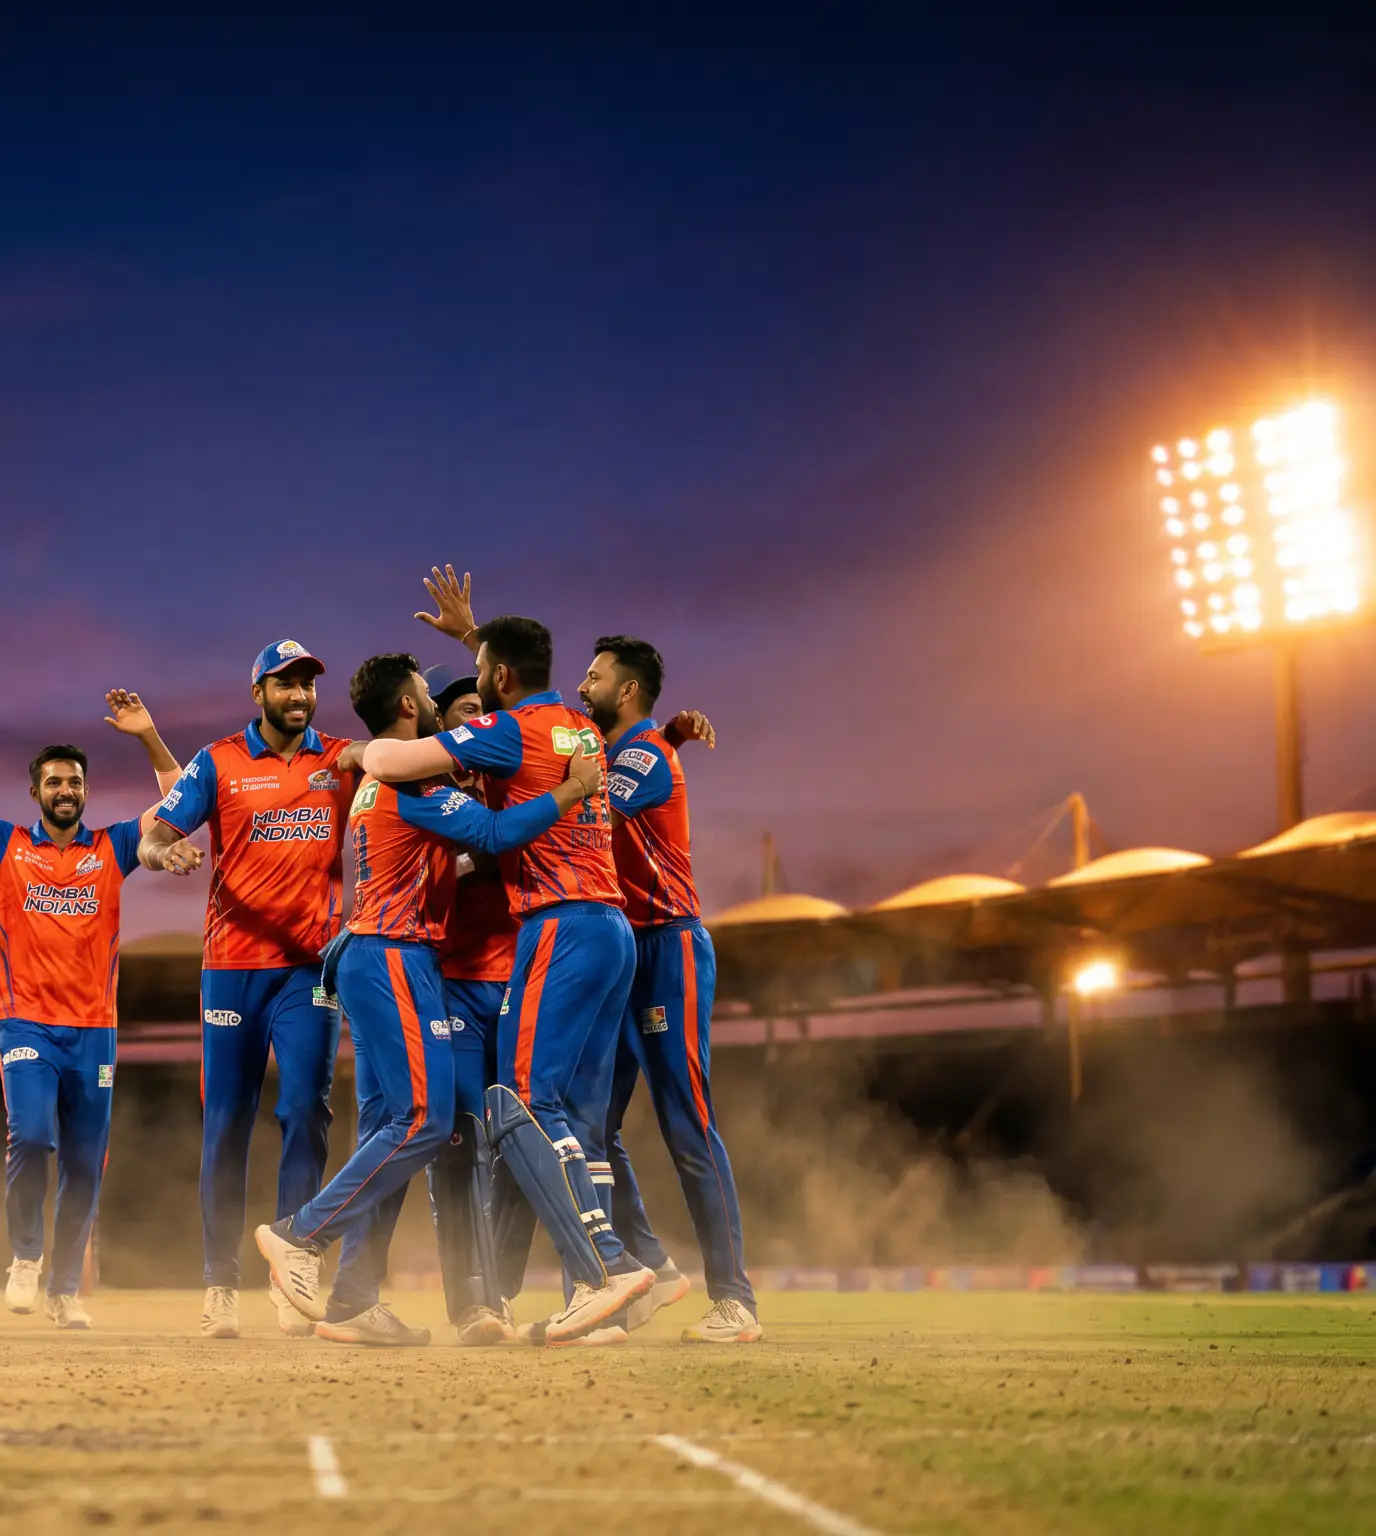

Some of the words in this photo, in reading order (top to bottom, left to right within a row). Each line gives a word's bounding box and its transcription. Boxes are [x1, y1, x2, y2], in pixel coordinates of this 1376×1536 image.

[252, 806, 331, 826] MUMBAI
[249, 823, 332, 842] INDIANS
[23, 896, 99, 915] INDIANS
